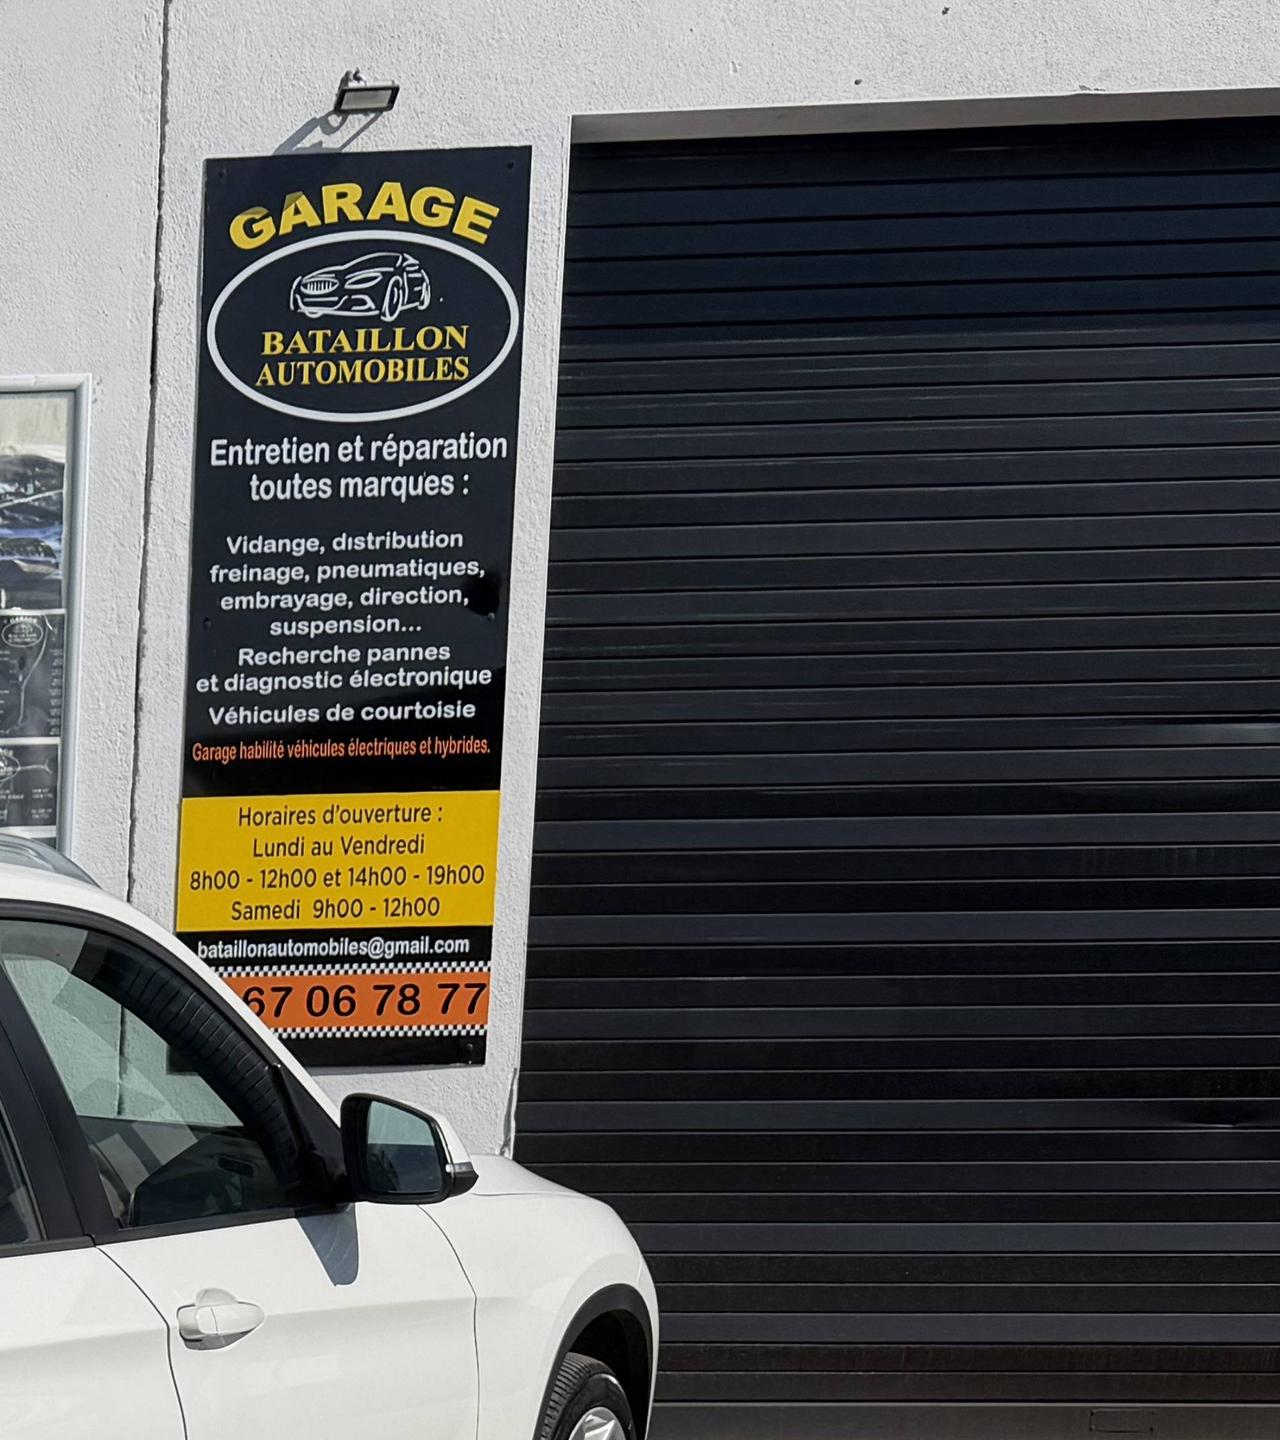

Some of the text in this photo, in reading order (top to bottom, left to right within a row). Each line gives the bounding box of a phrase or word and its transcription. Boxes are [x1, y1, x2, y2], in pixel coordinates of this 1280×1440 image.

[229, 181, 500, 250] GARAGE
[260, 325, 470, 356] BATAILLON
[255, 356, 470, 387] AUTOMOBILES
[210, 431, 508, 467] Entretien et réparation
[250, 473, 332, 501] toutes
[340, 472, 454, 503] marques
[226, 530, 464, 556] Vidange, distribution
[209, 558, 486, 585] freinage, pneumatiques,
[220, 585, 470, 612] embrayage, direction,
[269, 615, 422, 638] suspension...
[238, 644, 452, 667] Recherche pannes
[196, 666, 493, 695] et diagnostic électronique
[208, 700, 477, 725] Véhicules de courtoisie
[192, 735, 491, 765] Garage habilité véhicules électriques et hybrides.
[238, 805, 316, 827] Horaires
[322, 804, 432, 826] d'ouverture
[252, 833, 425, 858] Lundi au Vendredi
[190, 870, 240, 890] 8h00
[260, 868, 317, 889] 12h00
[323, 870, 341, 888] et
[348, 866, 407, 887] 14h00
[426, 864, 485, 885] 19h00
[231, 899, 301, 921] Samedi
[312, 898, 364, 919] 9h00
[383, 896, 441, 918] 12h00
[197, 936, 470, 960] bataillonautomobiles@gmail.com
[242, 982, 488, 1018] 67 06 78 77
